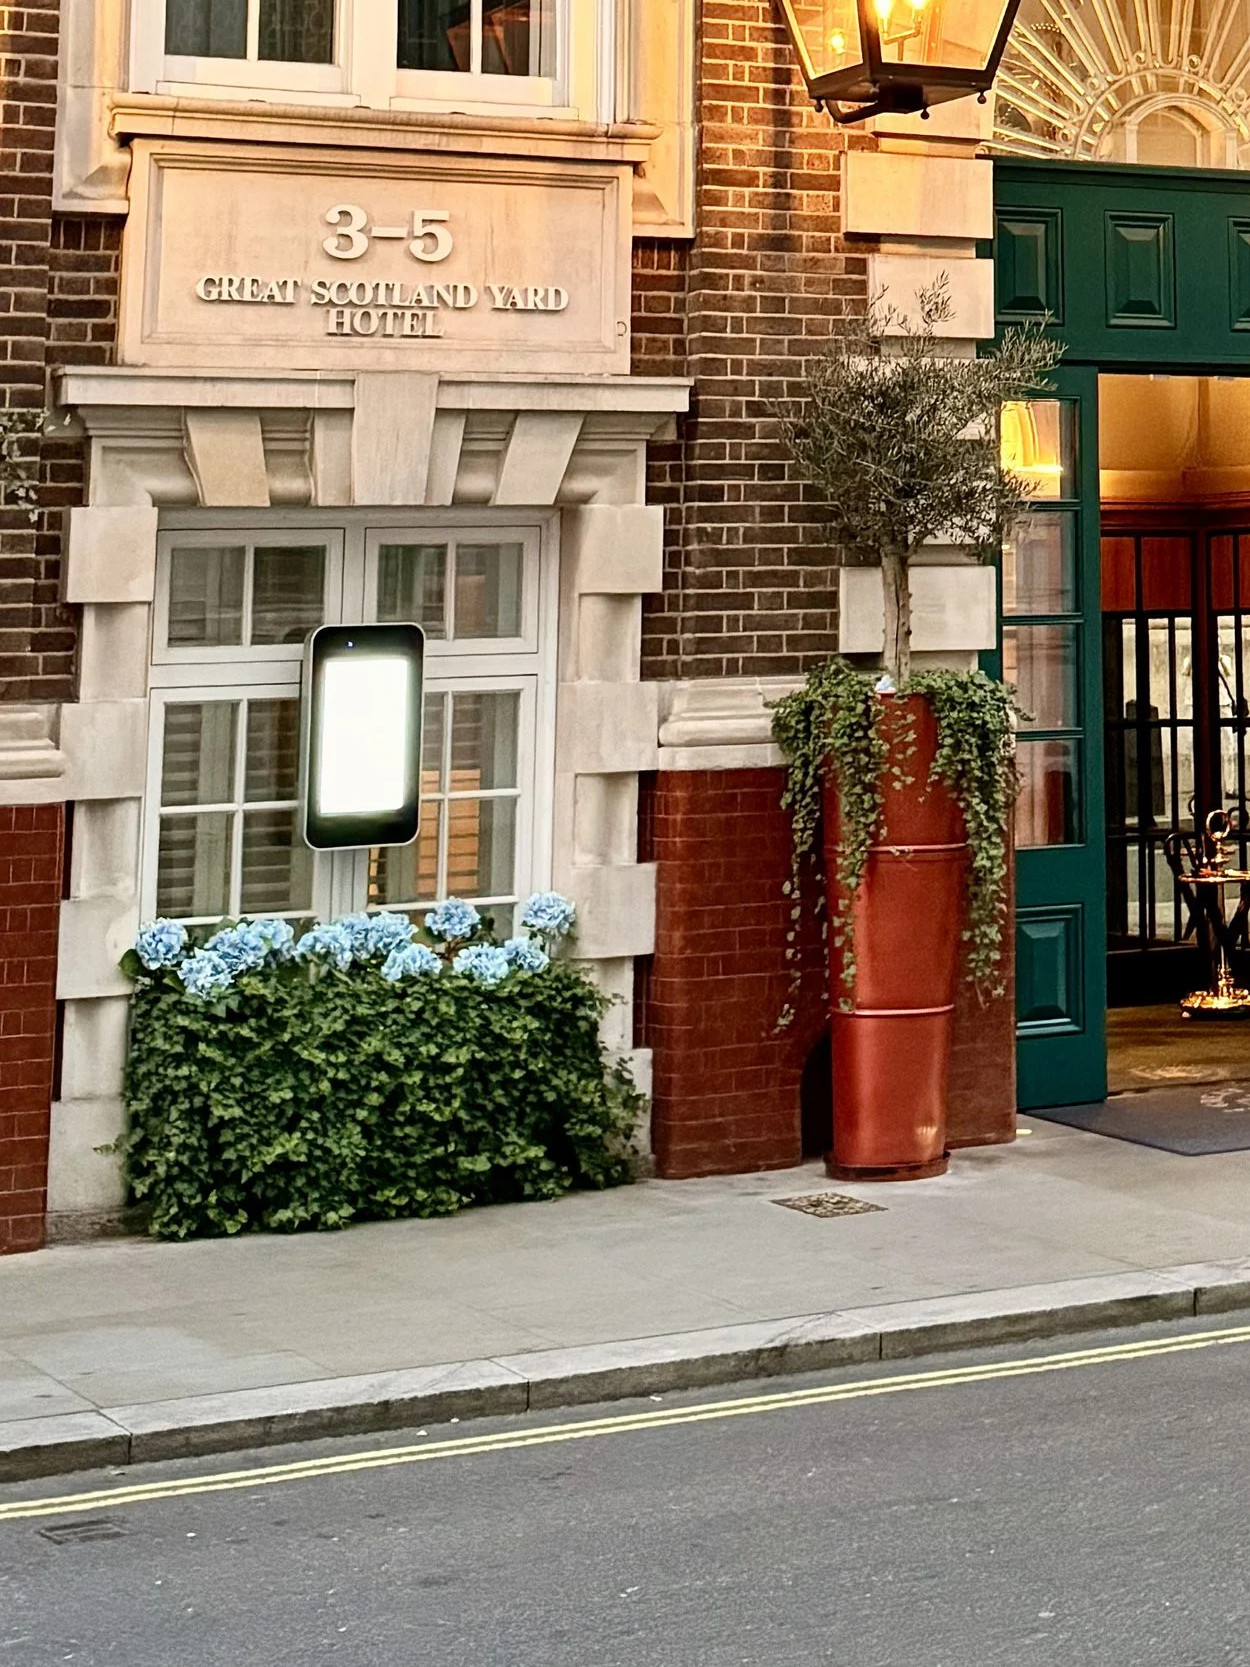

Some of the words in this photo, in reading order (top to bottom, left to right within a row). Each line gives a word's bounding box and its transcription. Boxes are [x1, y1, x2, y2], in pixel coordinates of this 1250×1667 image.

[195, 275, 300, 304] GREAT
[310, 279, 478, 309] SCOTLAND
[487, 284, 570, 311] YARD
[326, 307, 445, 338] HOTEL
